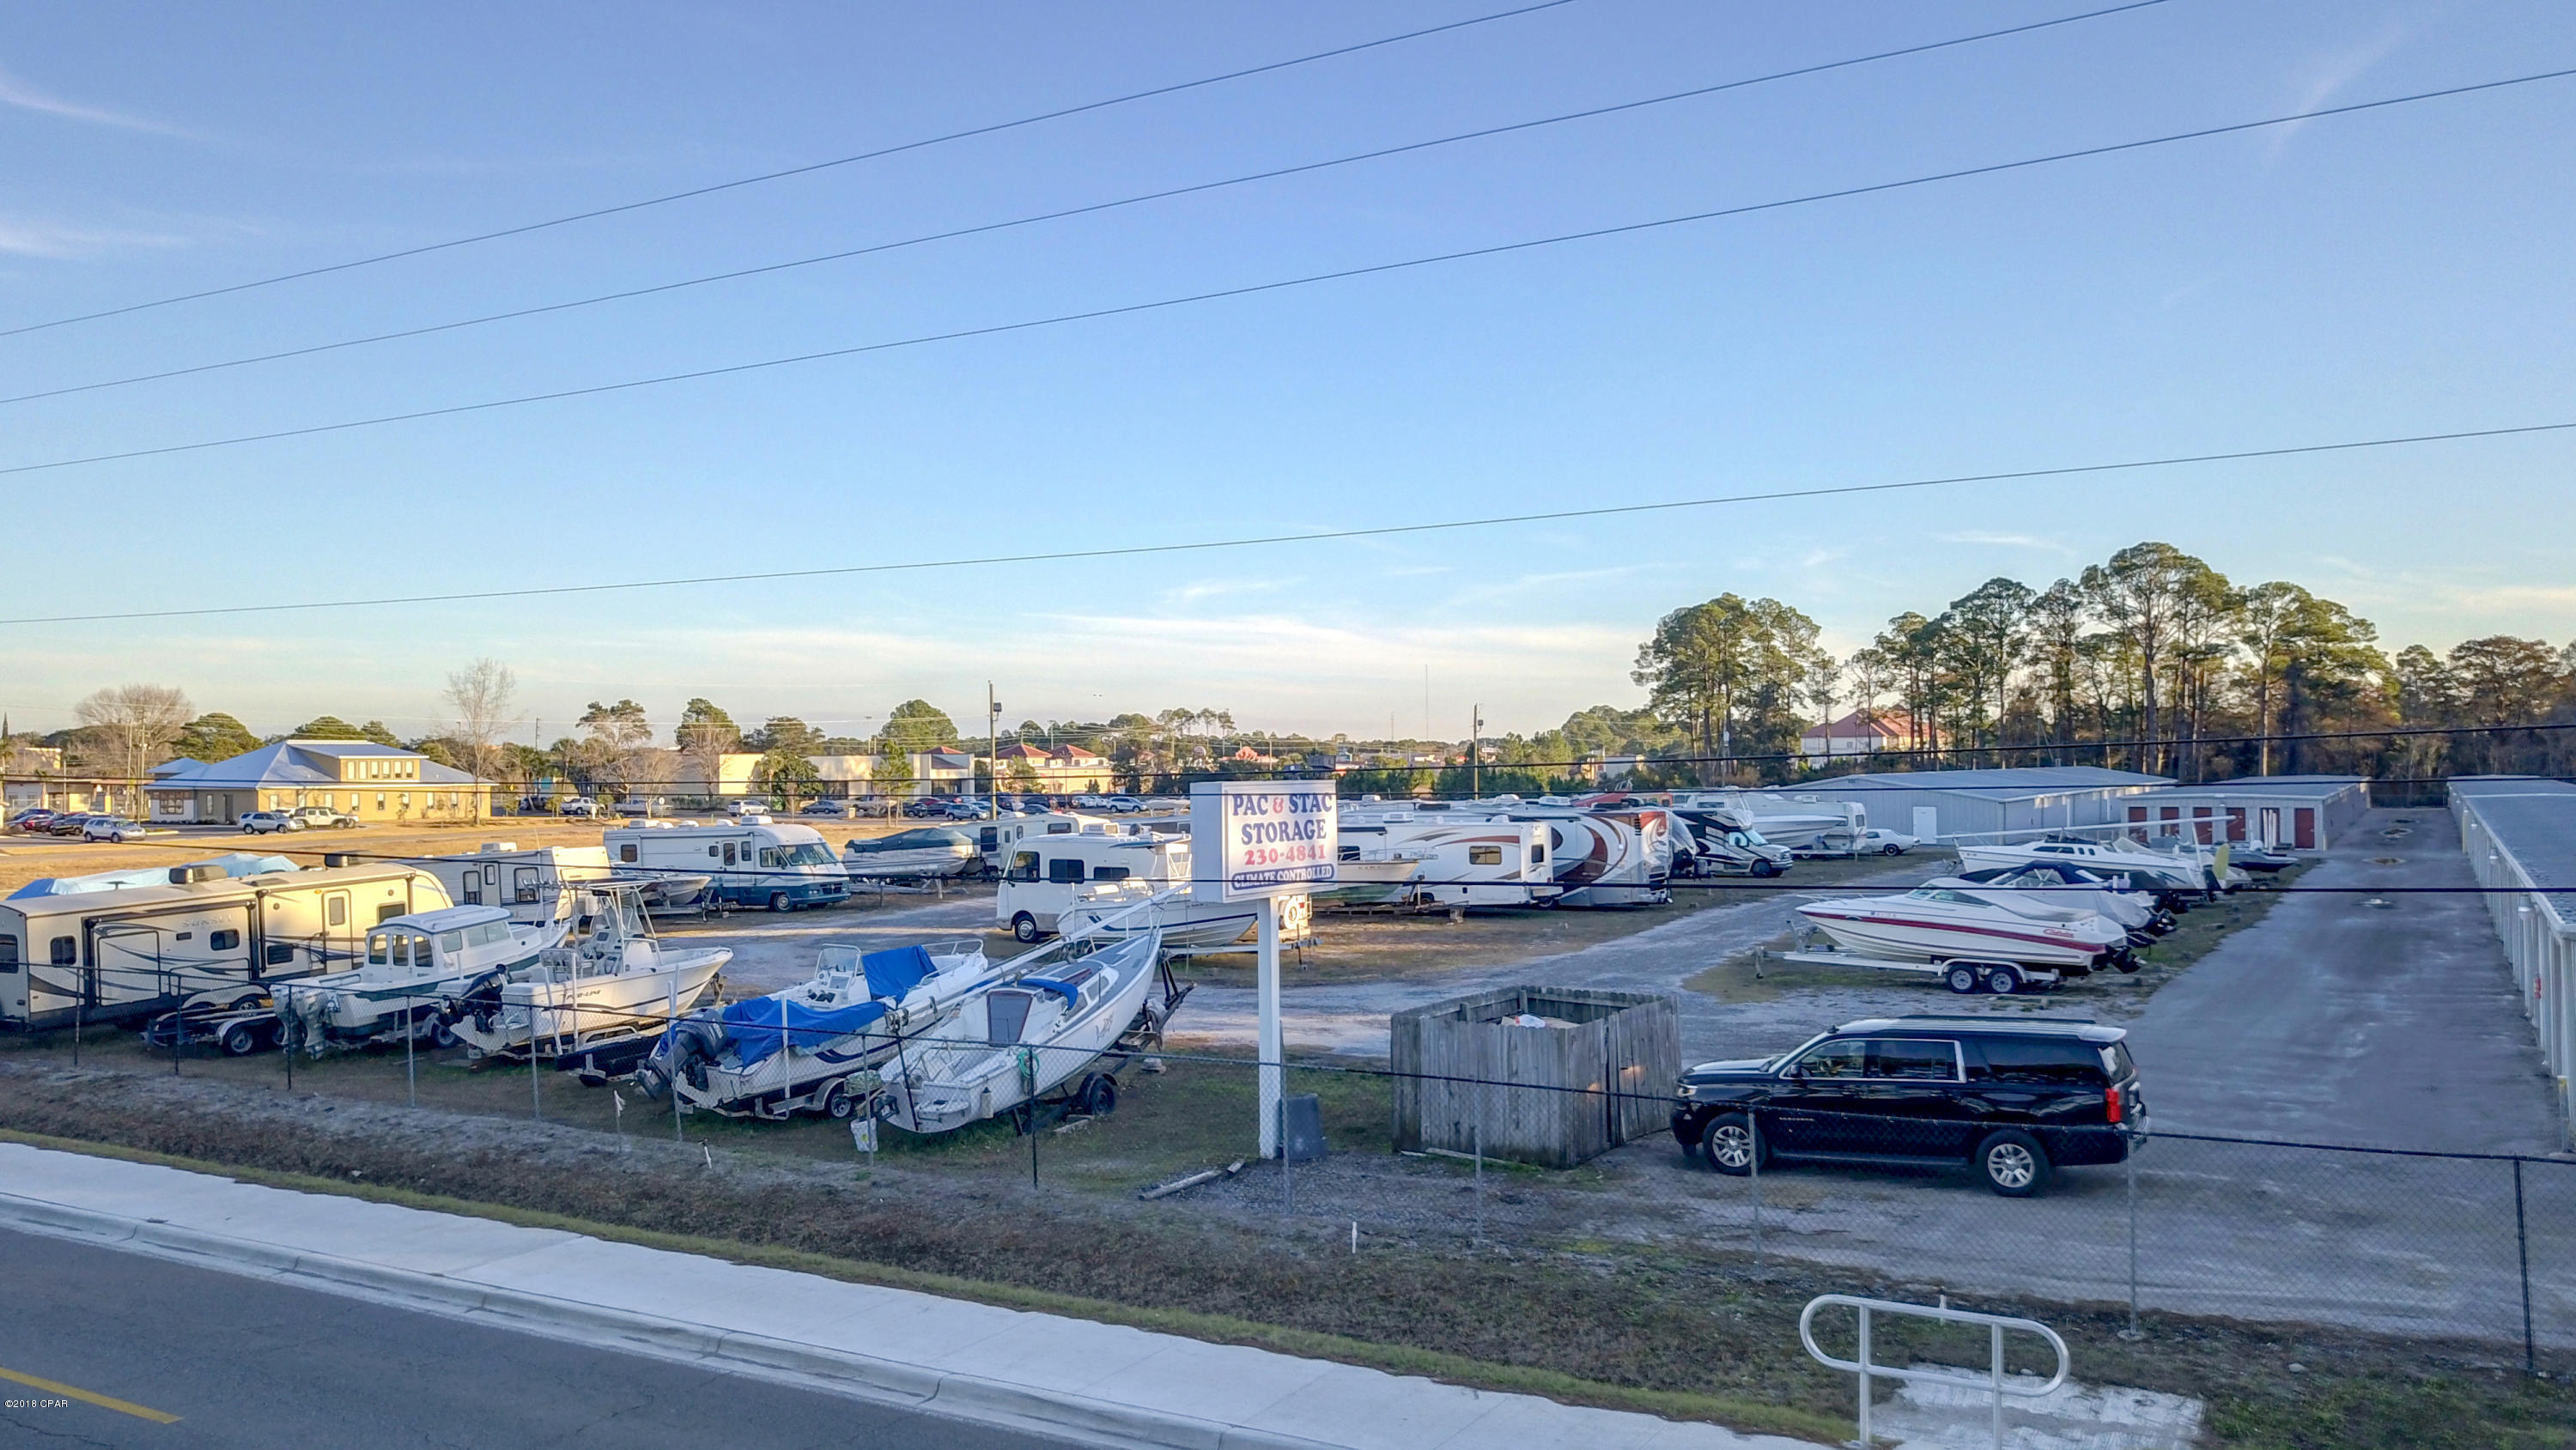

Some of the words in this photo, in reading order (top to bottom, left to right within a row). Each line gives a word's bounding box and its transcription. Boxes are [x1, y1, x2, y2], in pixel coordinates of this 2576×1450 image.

[1232, 793, 1268, 816] PAC
[1273, 797, 1284, 814] &
[1289, 792, 1332, 814] STAC
[1241, 818, 1327, 845] STORAGE
[1244, 844, 1327, 865] 230-4841
[1233, 871, 1276, 889] CLIMATE
[1277, 865, 1332, 882] CONTROLLED
